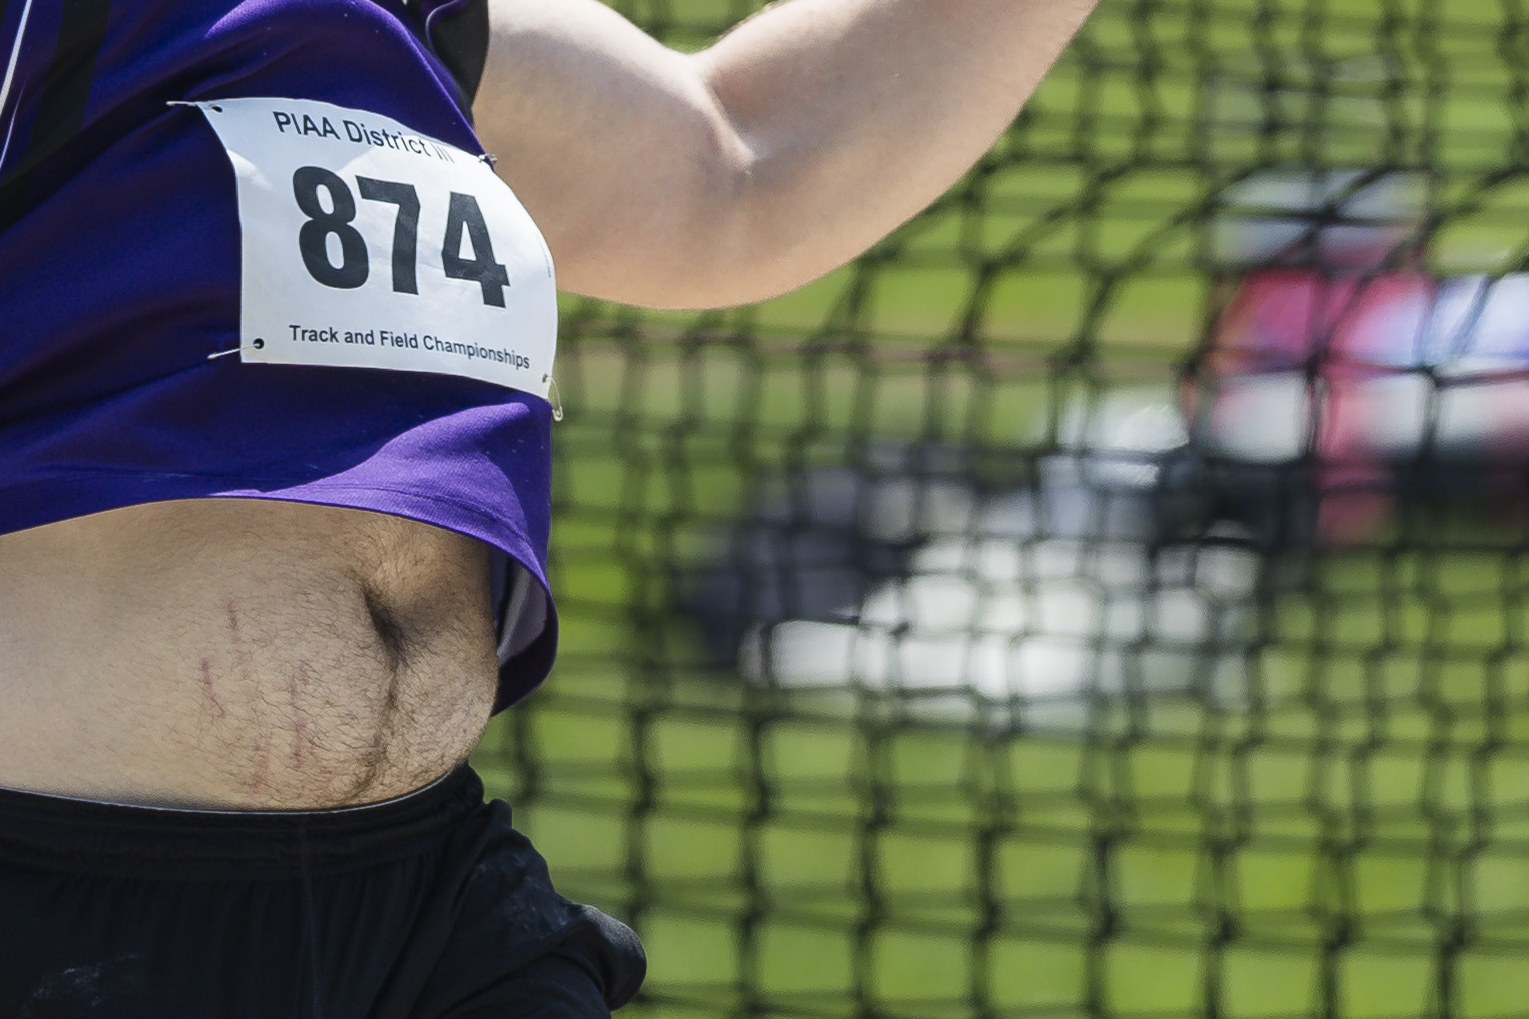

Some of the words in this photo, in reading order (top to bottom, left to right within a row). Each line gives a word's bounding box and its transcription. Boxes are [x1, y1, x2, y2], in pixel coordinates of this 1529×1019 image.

[273, 111, 341, 141] PIAA
[343, 119, 431, 158] District
[292, 165, 511, 309] 874
[289, 324, 339, 343] Track
[344, 329, 375, 345] and
[379, 330, 419, 349] Field
[422, 335, 531, 371] Championships
